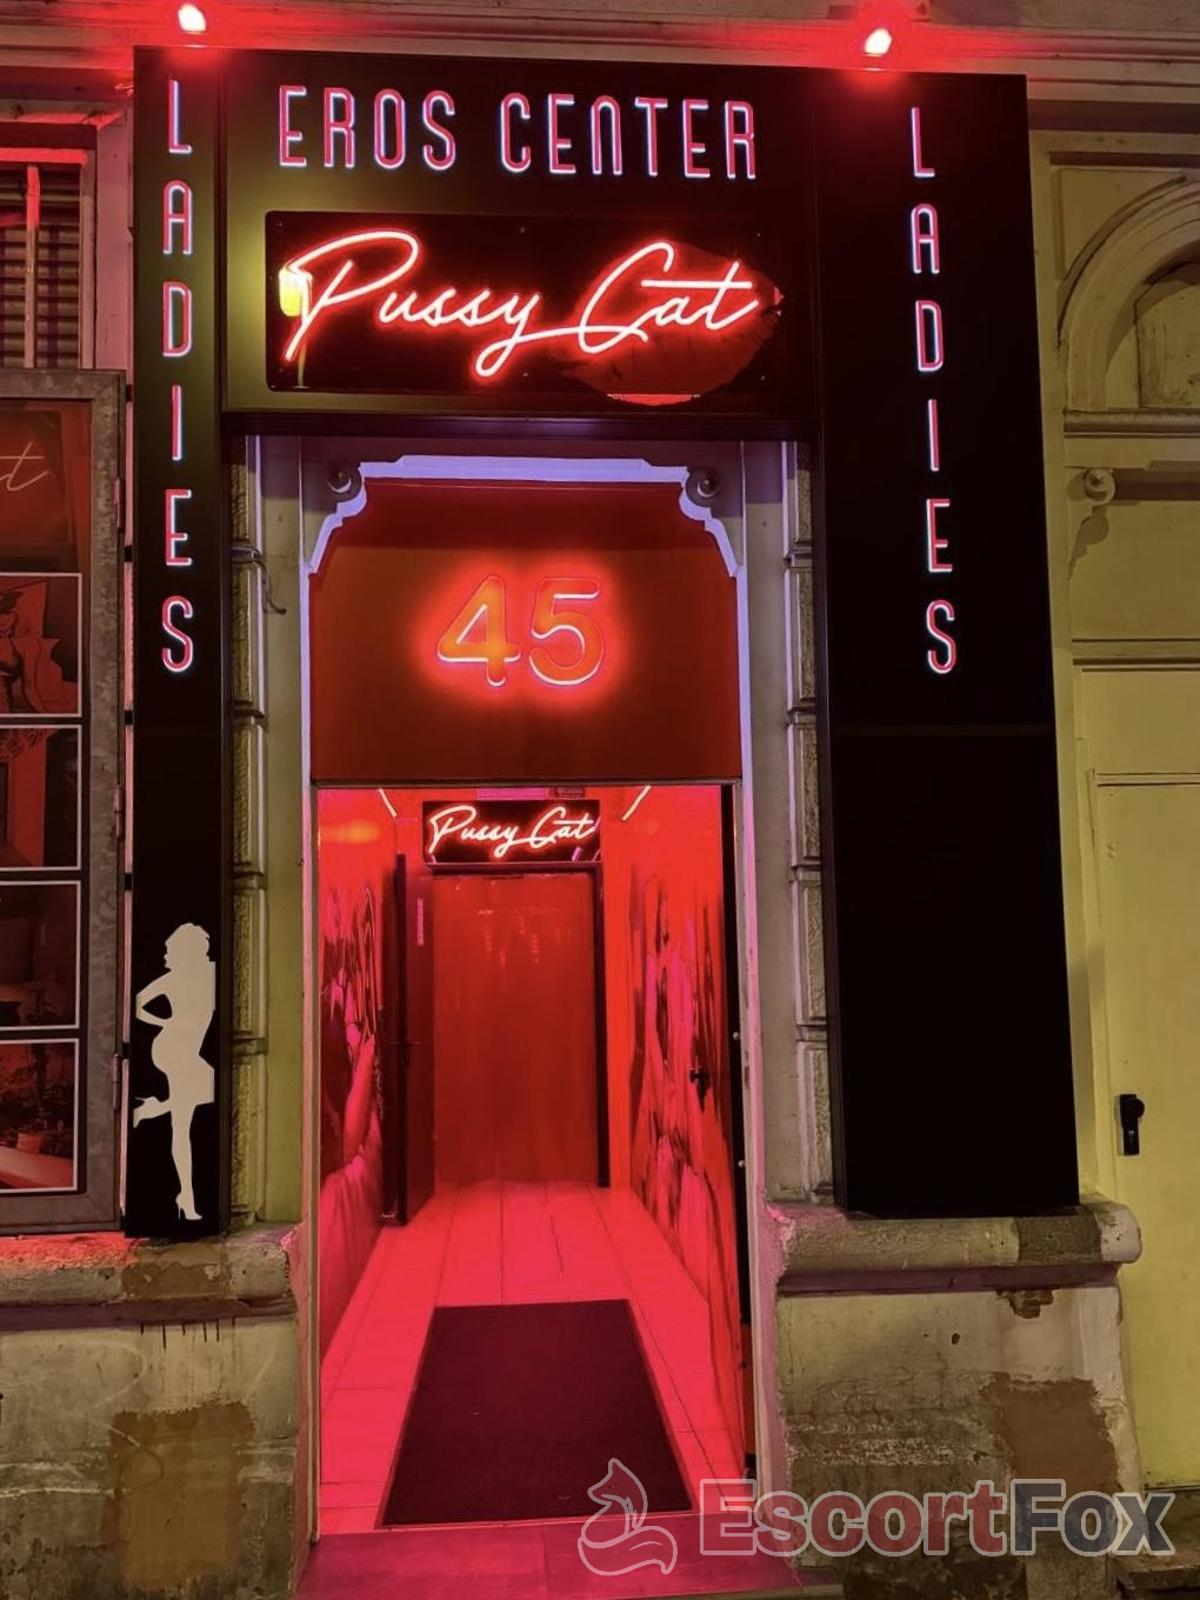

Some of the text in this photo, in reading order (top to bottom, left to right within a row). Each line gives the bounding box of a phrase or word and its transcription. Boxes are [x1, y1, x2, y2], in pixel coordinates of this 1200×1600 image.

[279, 85, 756, 180] EROS CENTER
[283, 230, 759, 377] Pussy Cat
[161, 80, 194, 673] LADIES
[909, 106, 957, 674] LADIES
[437, 575, 605, 687] 45
[428, 804, 596, 858] Pussy Cat
